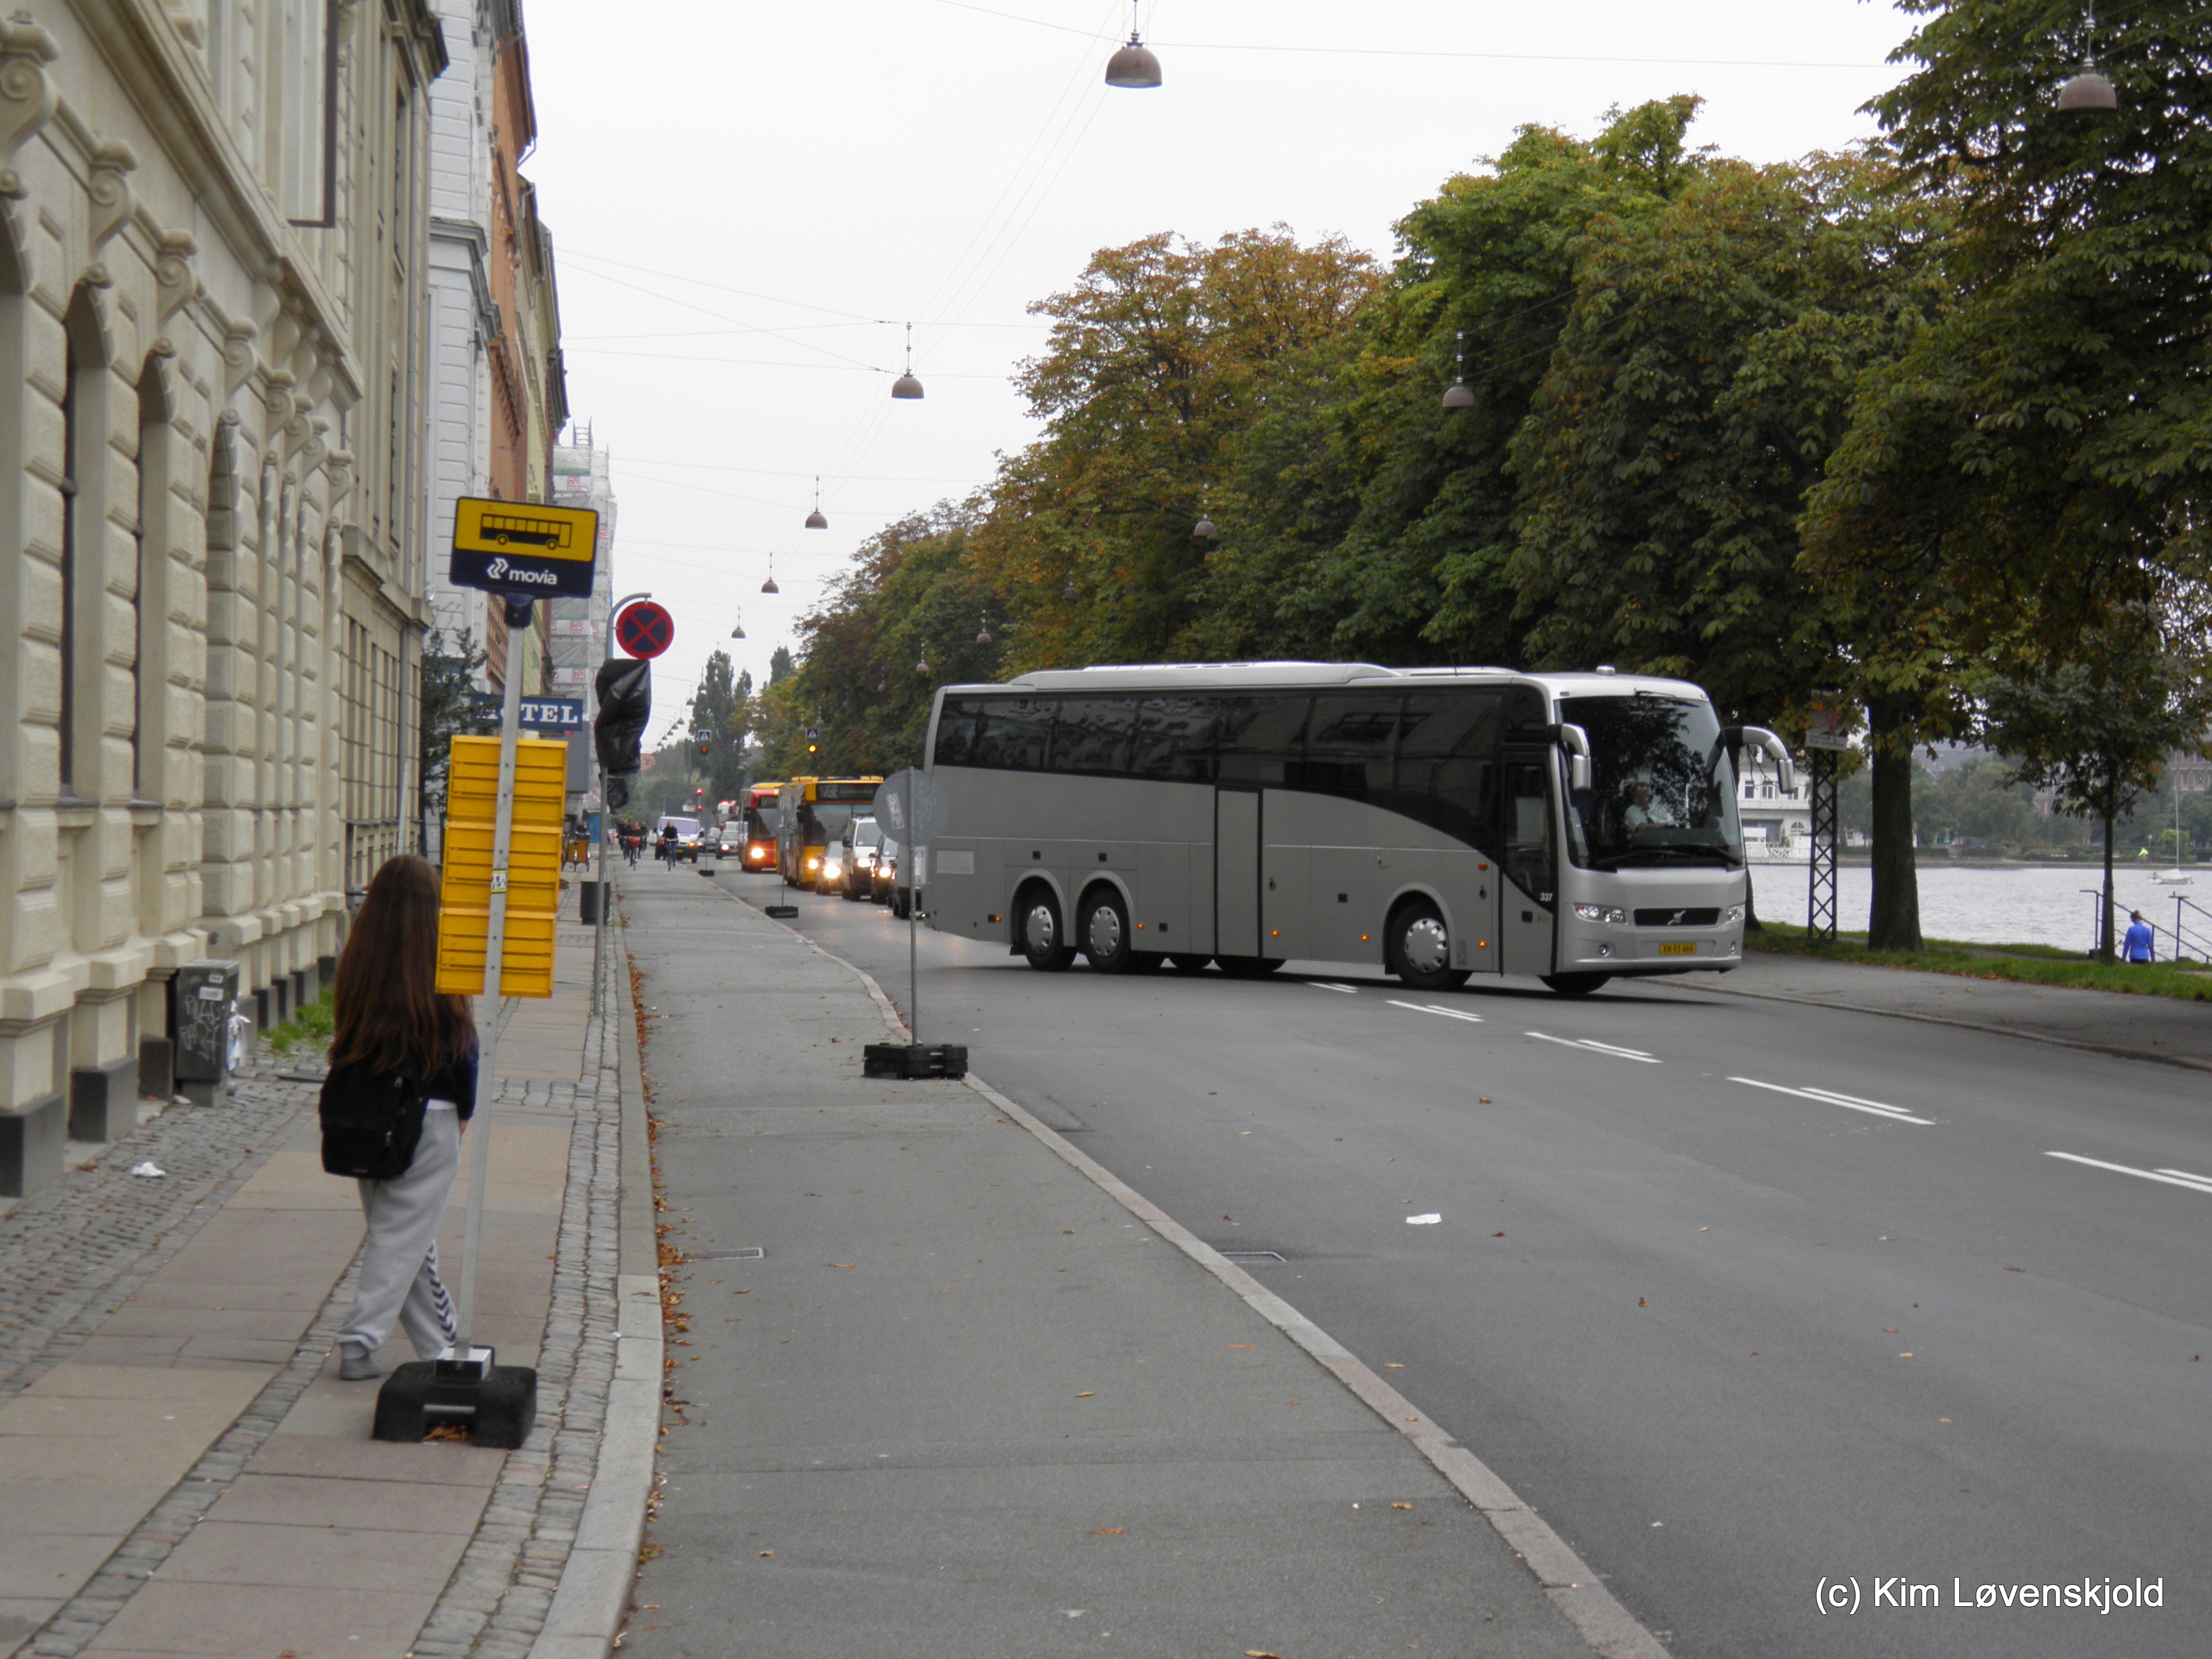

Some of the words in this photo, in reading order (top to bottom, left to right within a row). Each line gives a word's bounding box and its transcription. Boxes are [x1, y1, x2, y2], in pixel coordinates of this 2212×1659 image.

[509, 569, 558, 585] movia
[476, 702, 579, 724] TEL
[1540, 893, 1553, 902] 337
